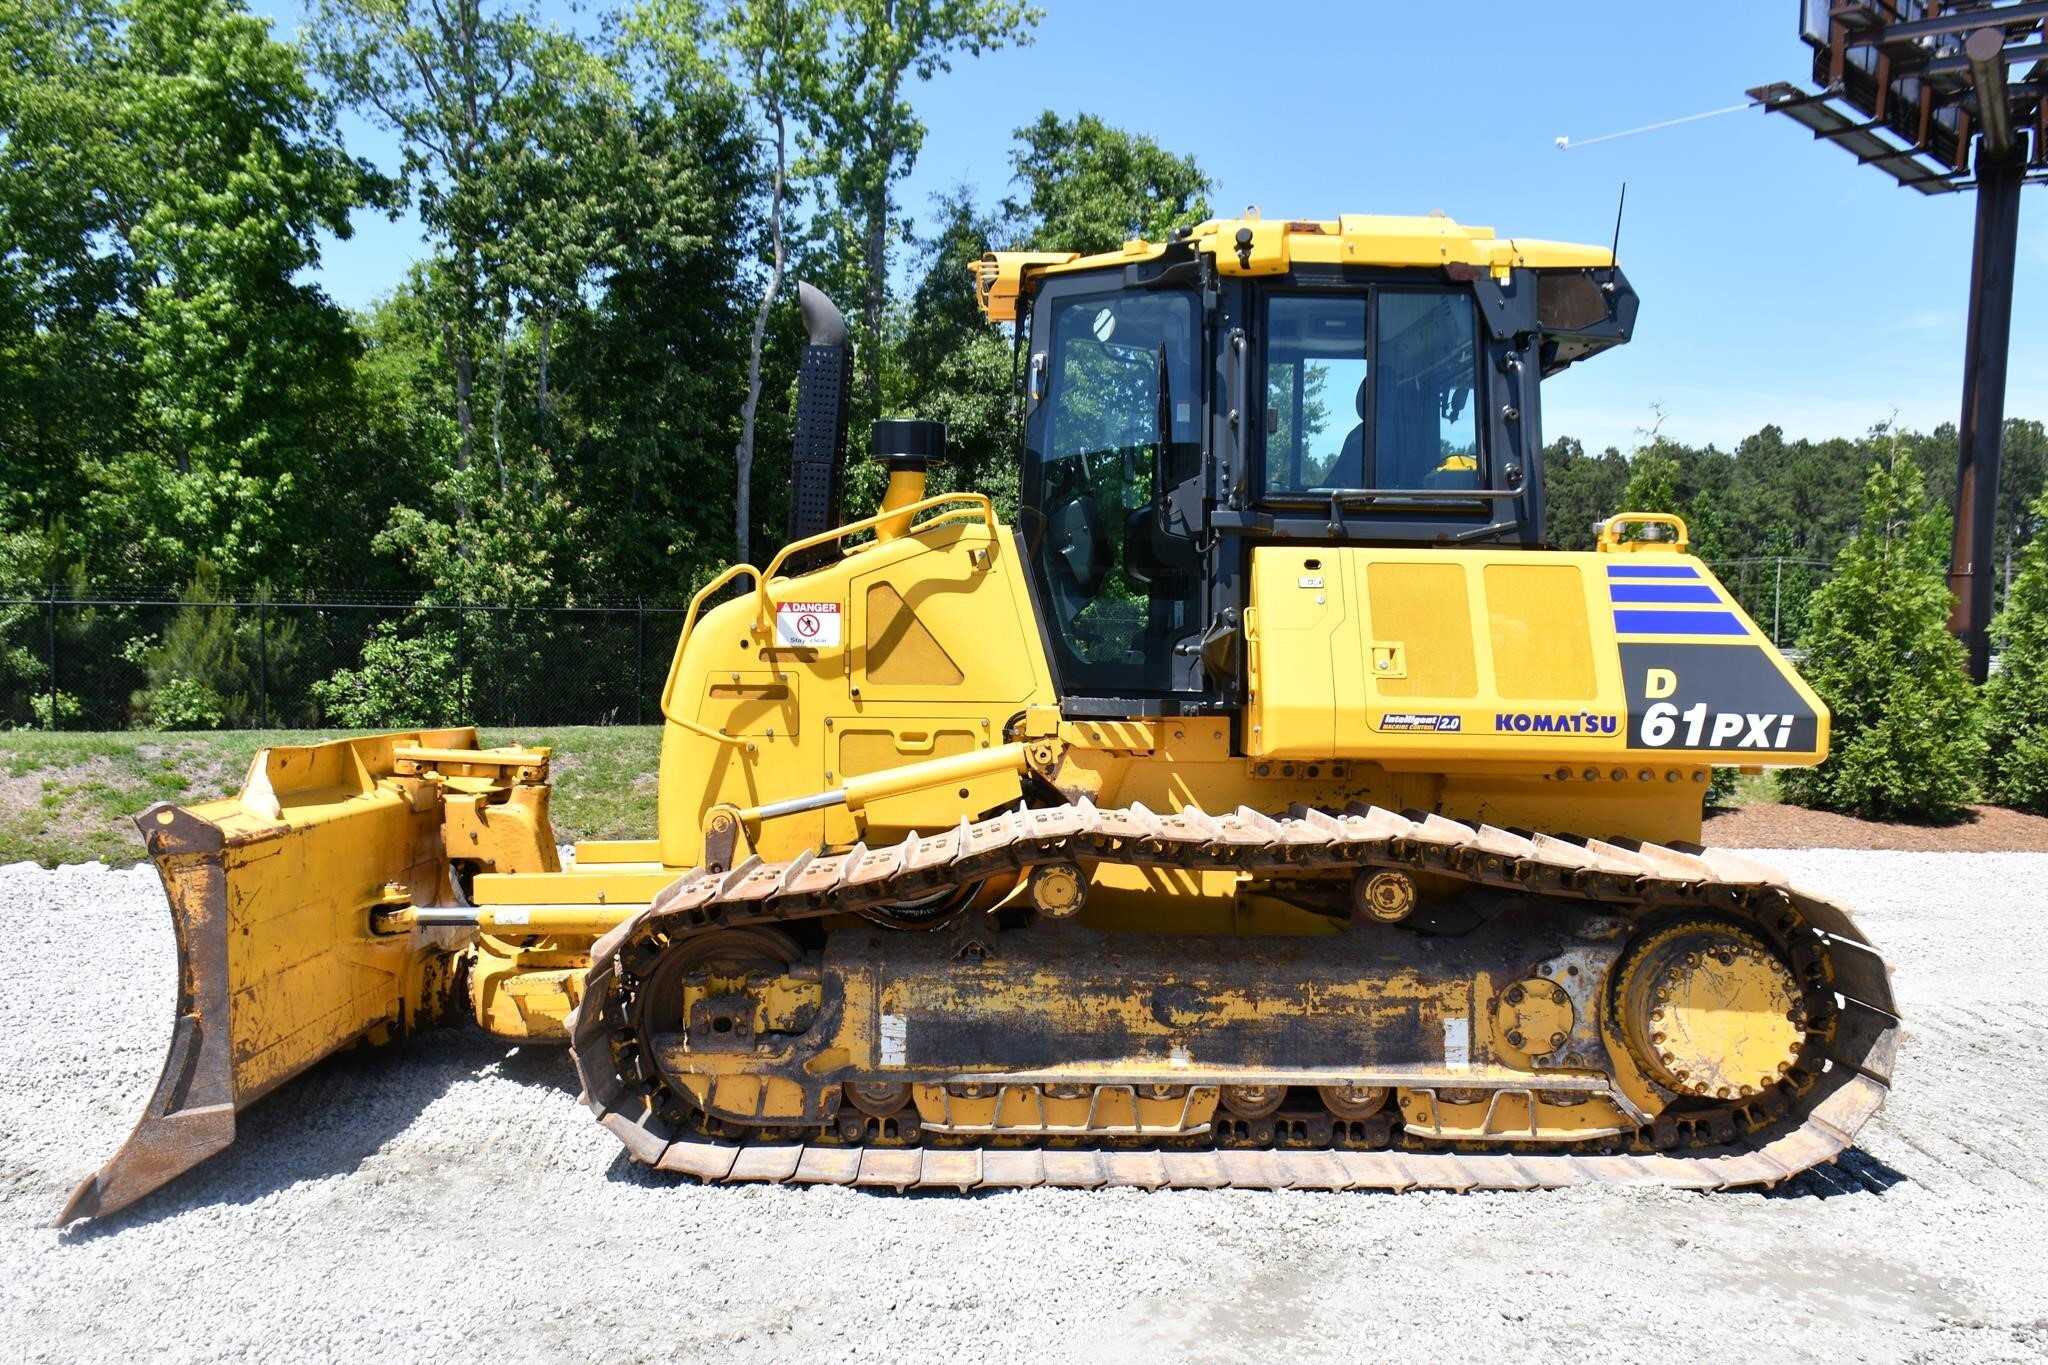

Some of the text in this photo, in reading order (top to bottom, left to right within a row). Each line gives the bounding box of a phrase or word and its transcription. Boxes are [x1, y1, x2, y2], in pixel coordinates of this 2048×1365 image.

[792, 603, 837, 613] DANGER
[790, 637, 806, 645] Stay
[1645, 668, 1677, 699] D
[1384, 714, 1459, 729] Intelligent 2.0
[1495, 711, 1617, 734] KOMATSU
[1640, 702, 1795, 748] 61PXi
